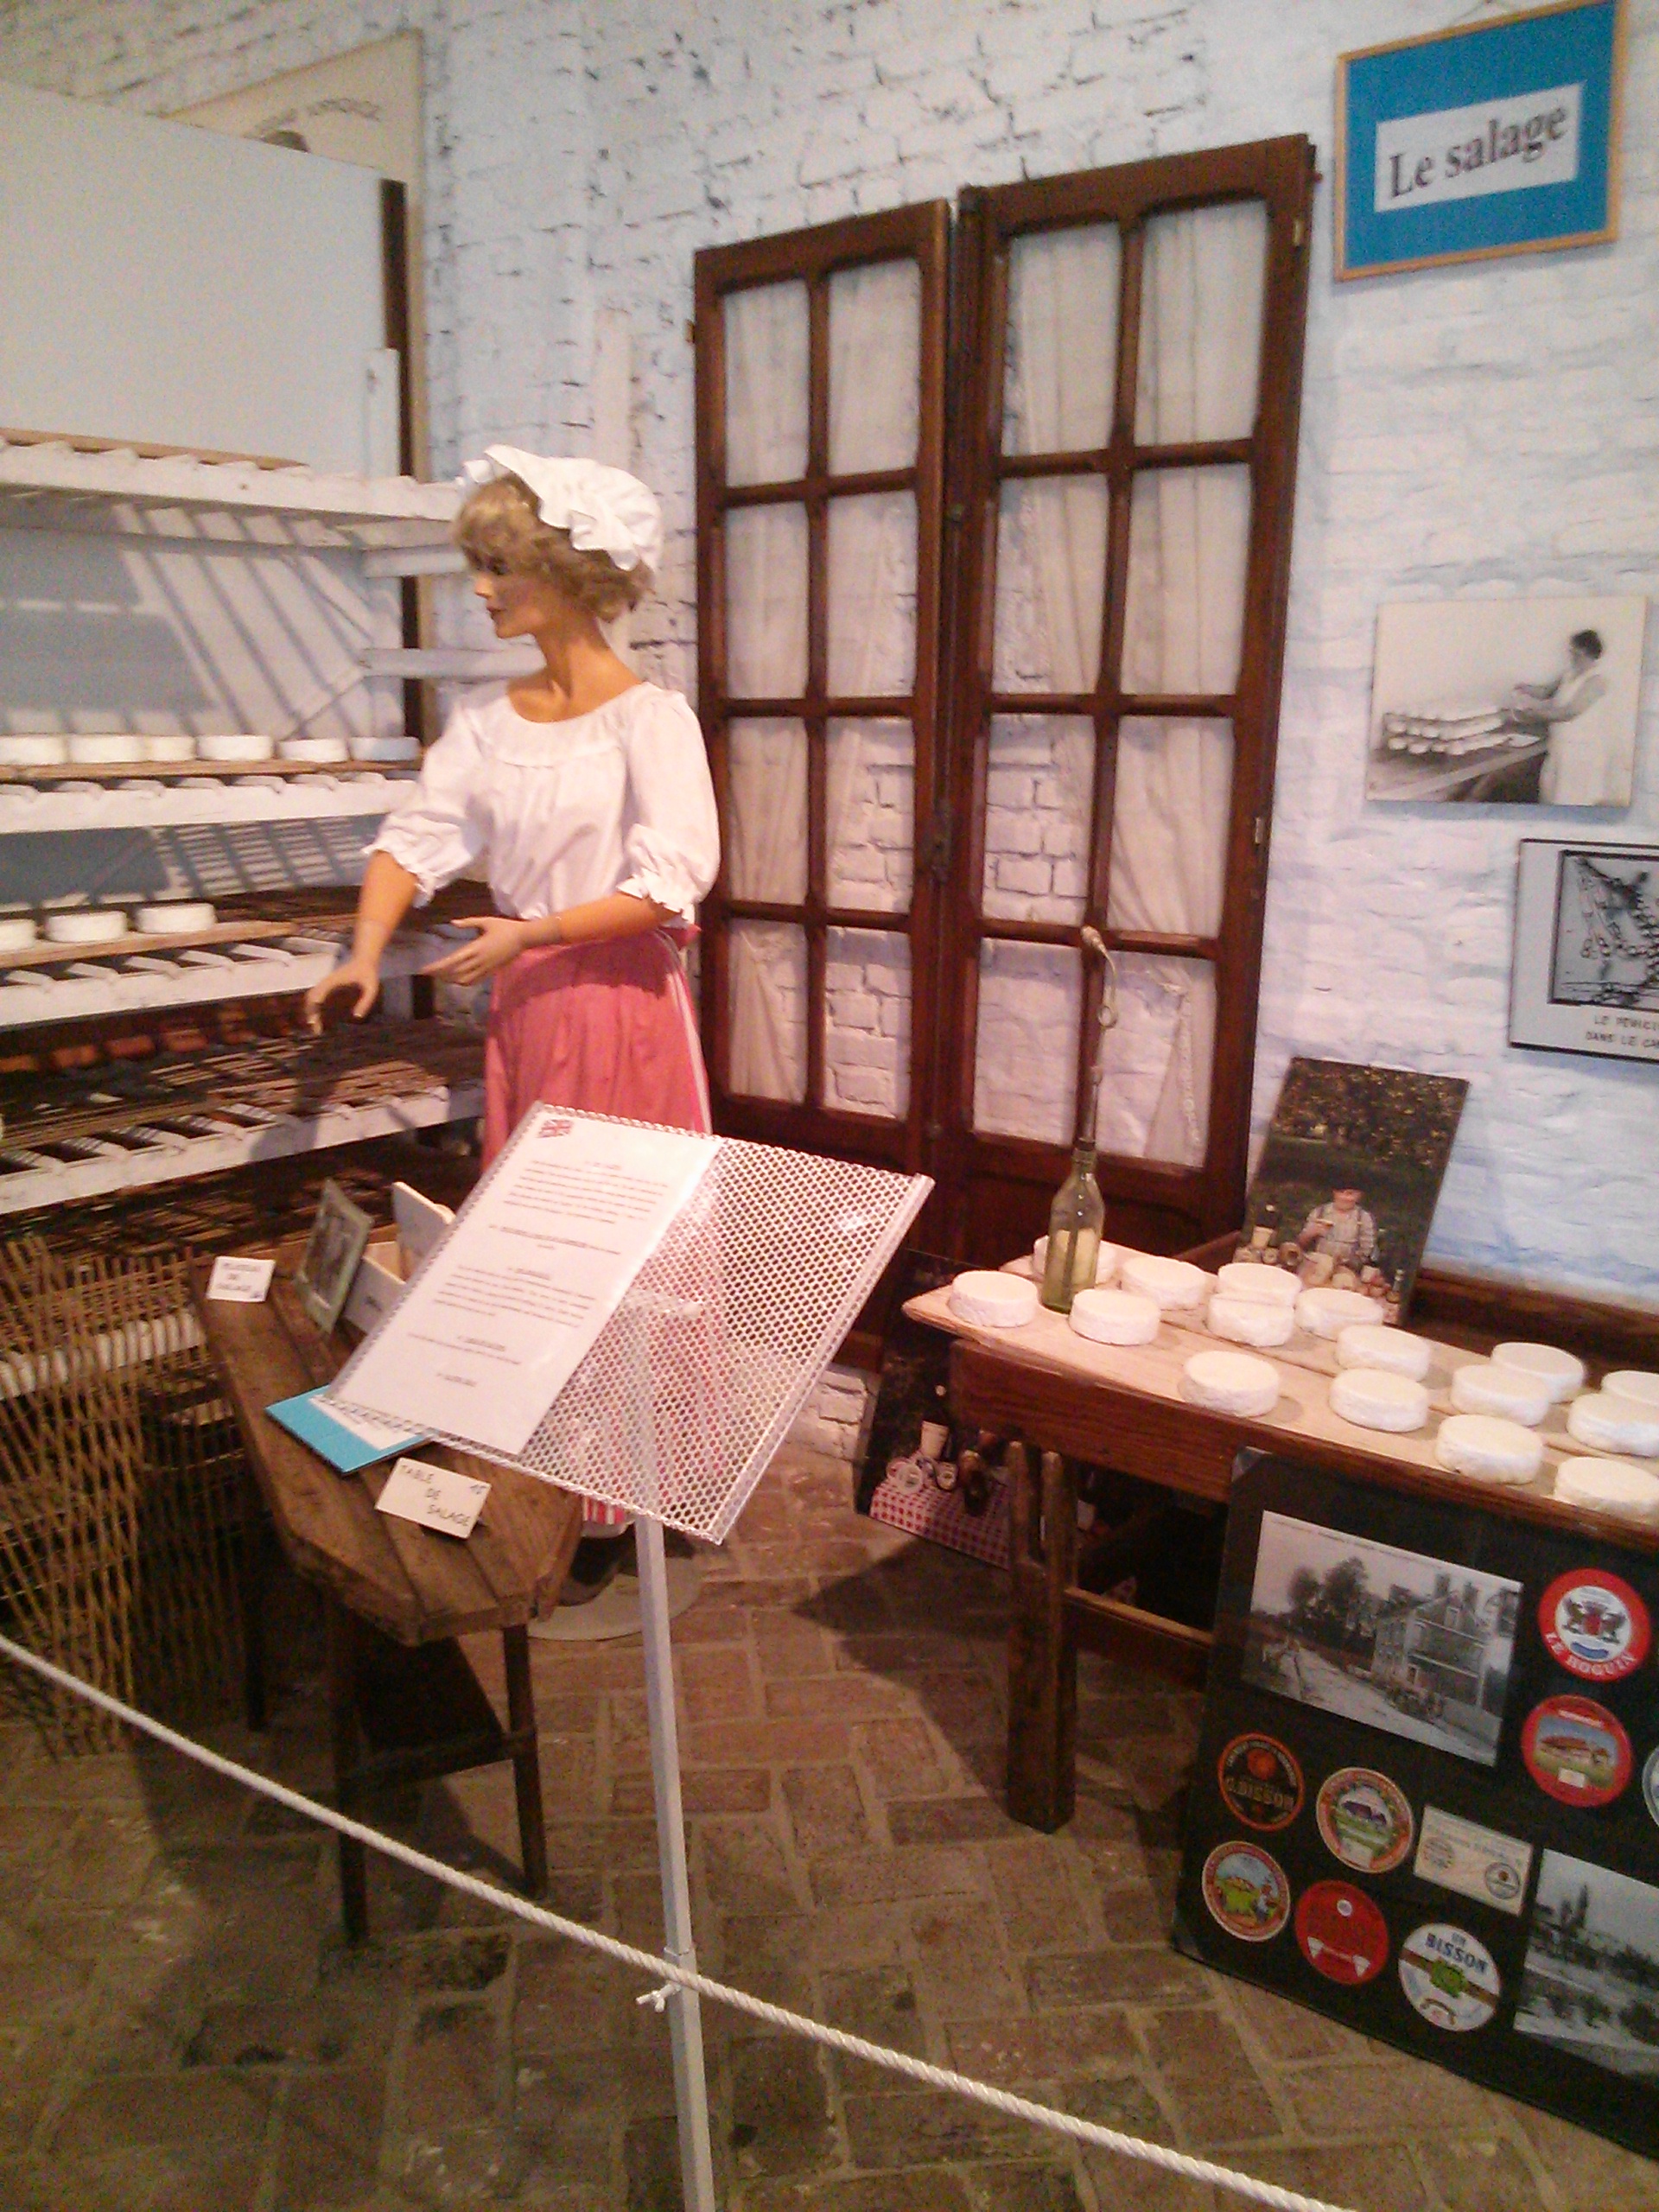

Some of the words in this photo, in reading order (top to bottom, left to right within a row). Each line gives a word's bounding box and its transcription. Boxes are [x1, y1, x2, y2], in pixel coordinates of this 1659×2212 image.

[1389, 152, 1433, 198] Le
[1446, 107, 1568, 178] salage
[1621, 1036, 1637, 1046] LE
[427, 1503, 471, 1527] SALAGE
[1425, 1932, 1488, 1974] BISSON
